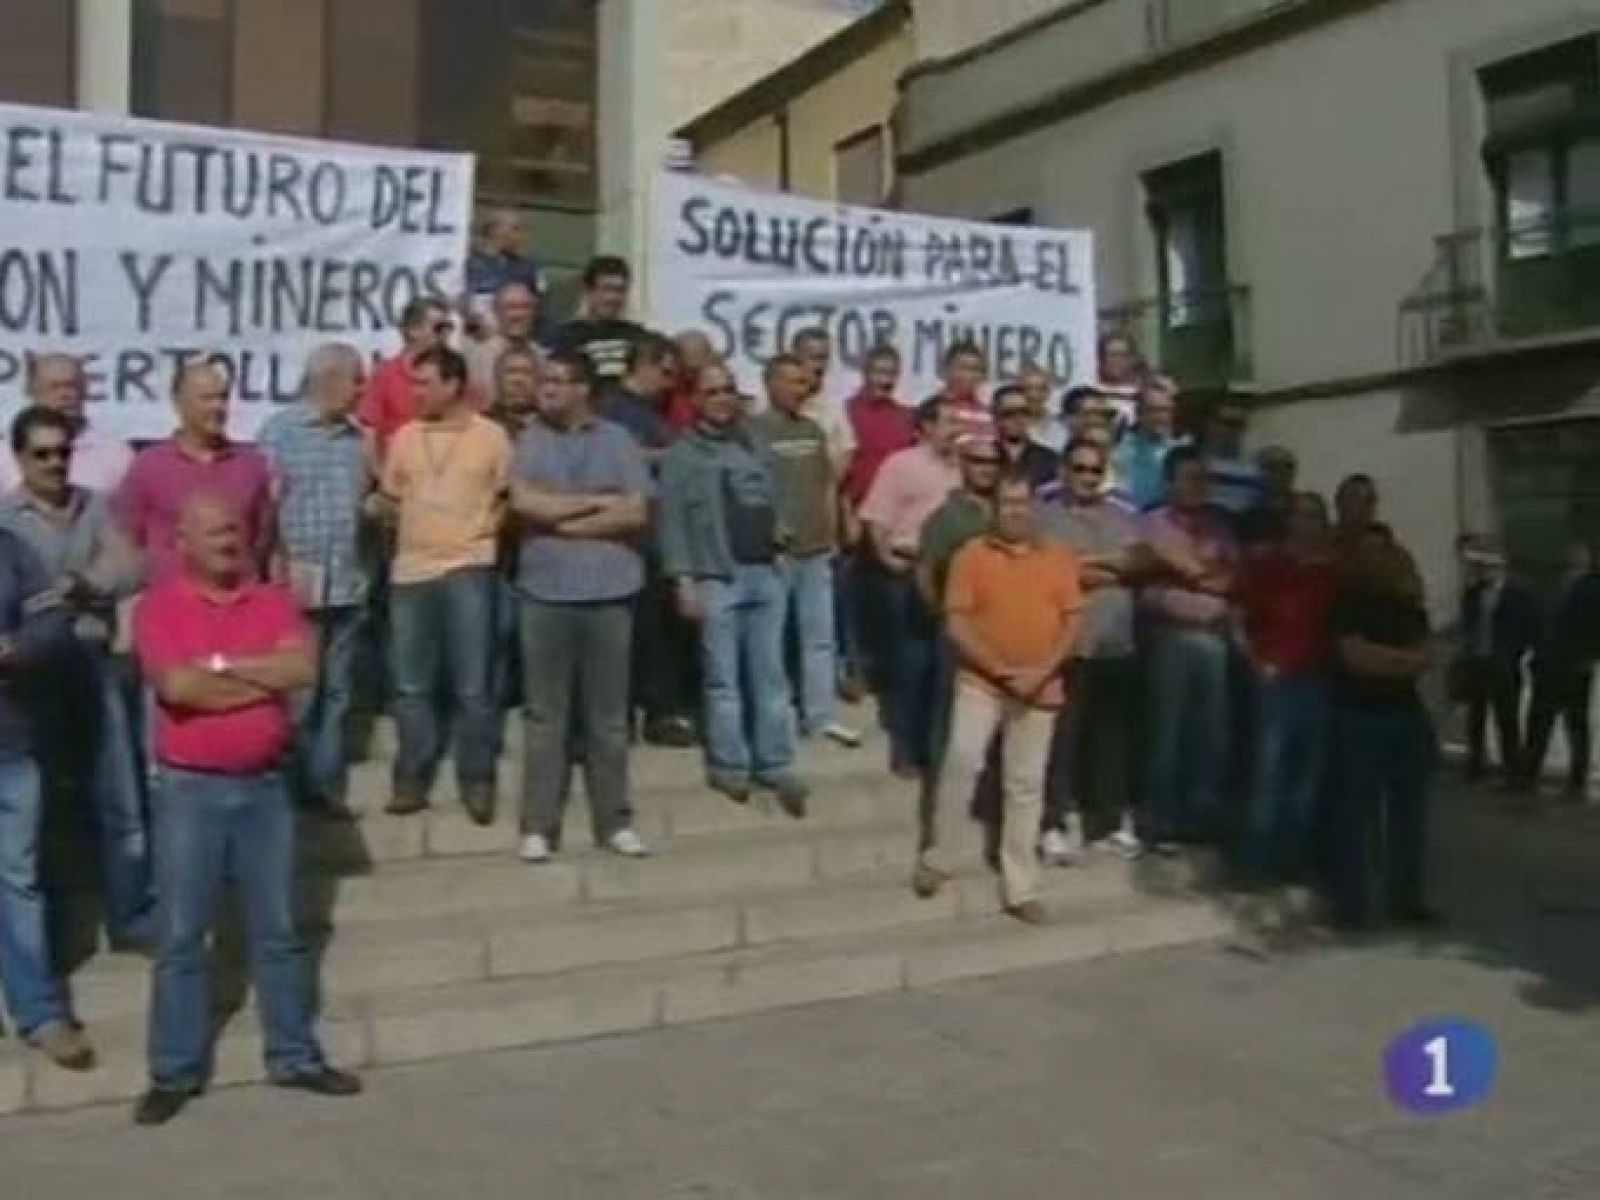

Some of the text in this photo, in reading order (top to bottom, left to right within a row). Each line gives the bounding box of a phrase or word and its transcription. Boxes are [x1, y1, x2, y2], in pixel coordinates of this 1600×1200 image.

[4, 126, 455, 234] EL FUTURO DEL
[120, 251, 172, 334] Y
[925, 228, 1018, 286] PARA
[1034, 240, 1080, 294] EL
